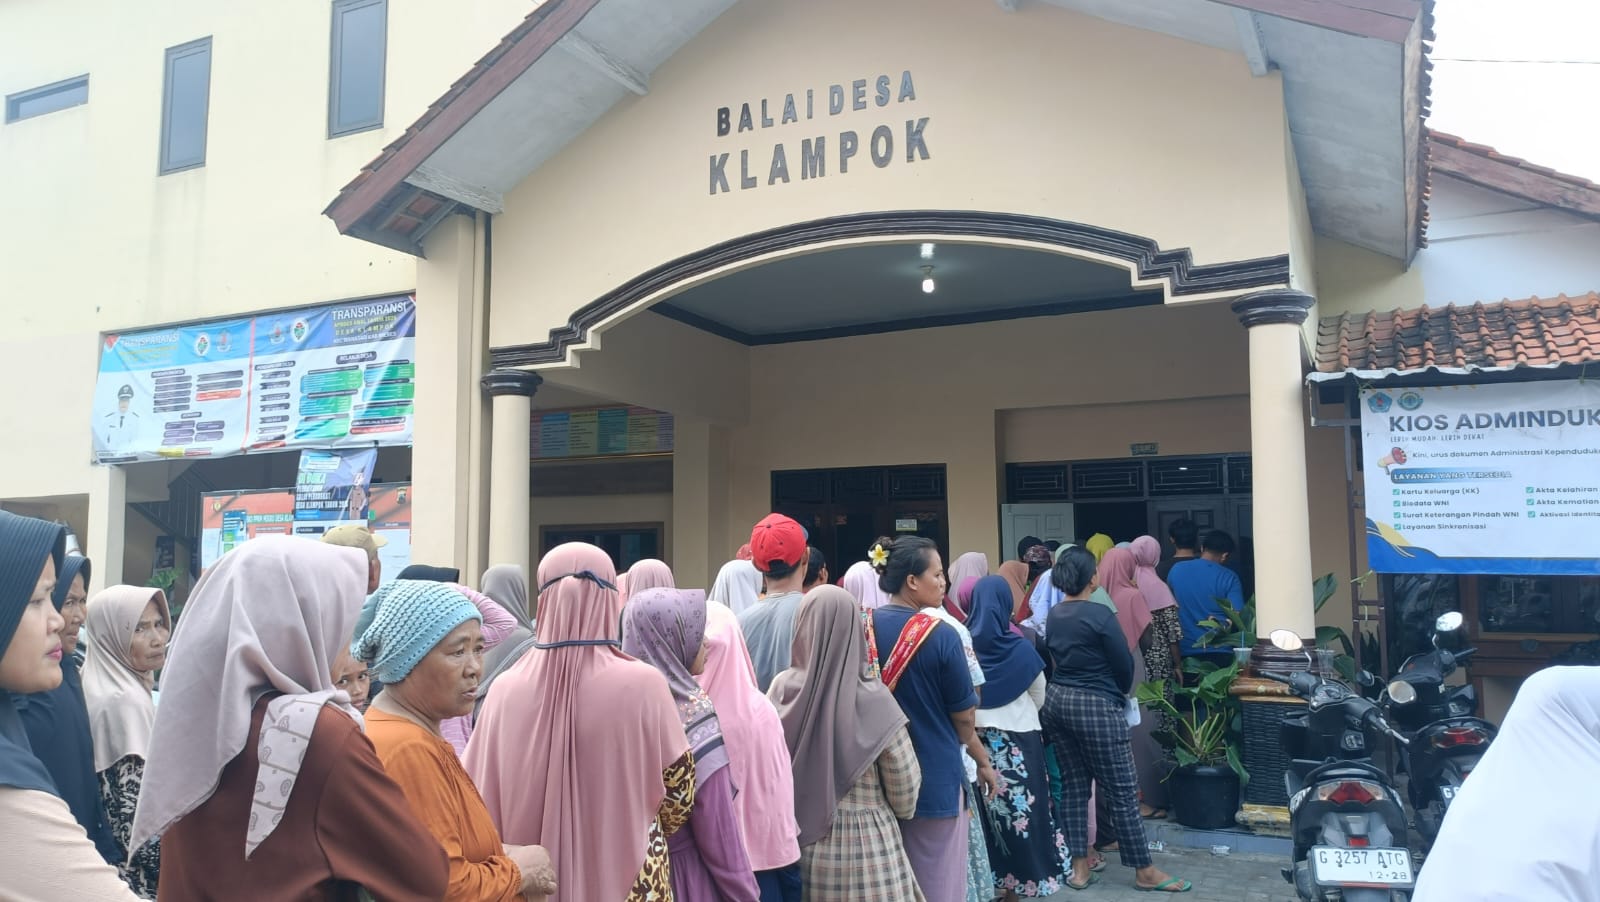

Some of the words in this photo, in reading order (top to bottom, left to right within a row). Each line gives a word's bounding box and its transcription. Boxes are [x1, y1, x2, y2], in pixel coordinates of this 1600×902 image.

[717, 89, 814, 137] BALAI
[829, 70, 916, 116] DESA
[709, 117, 930, 195] KLAMPOK
[1389, 414, 1449, 432] KIOS
[1455, 408, 1600, 430] ADMINDUK
[1441, 434, 1461, 442] LEBIH
[1463, 433, 1485, 441] DEKAT
[1450, 450, 1489, 458] dokumen
[1490, 448, 1543, 457] Administrasi
[1438, 472, 1466, 480] YANG
[1467, 471, 1512, 479] TERSEDIA
[1424, 488, 1460, 496] Keluarga
[1461, 487, 1481, 495] (KK)
[1424, 511, 1471, 519] Keterangan
[1320, 851, 1328, 864] G
[1334, 851, 1368, 864] 3257
[1377, 851, 1404, 866] ATG
